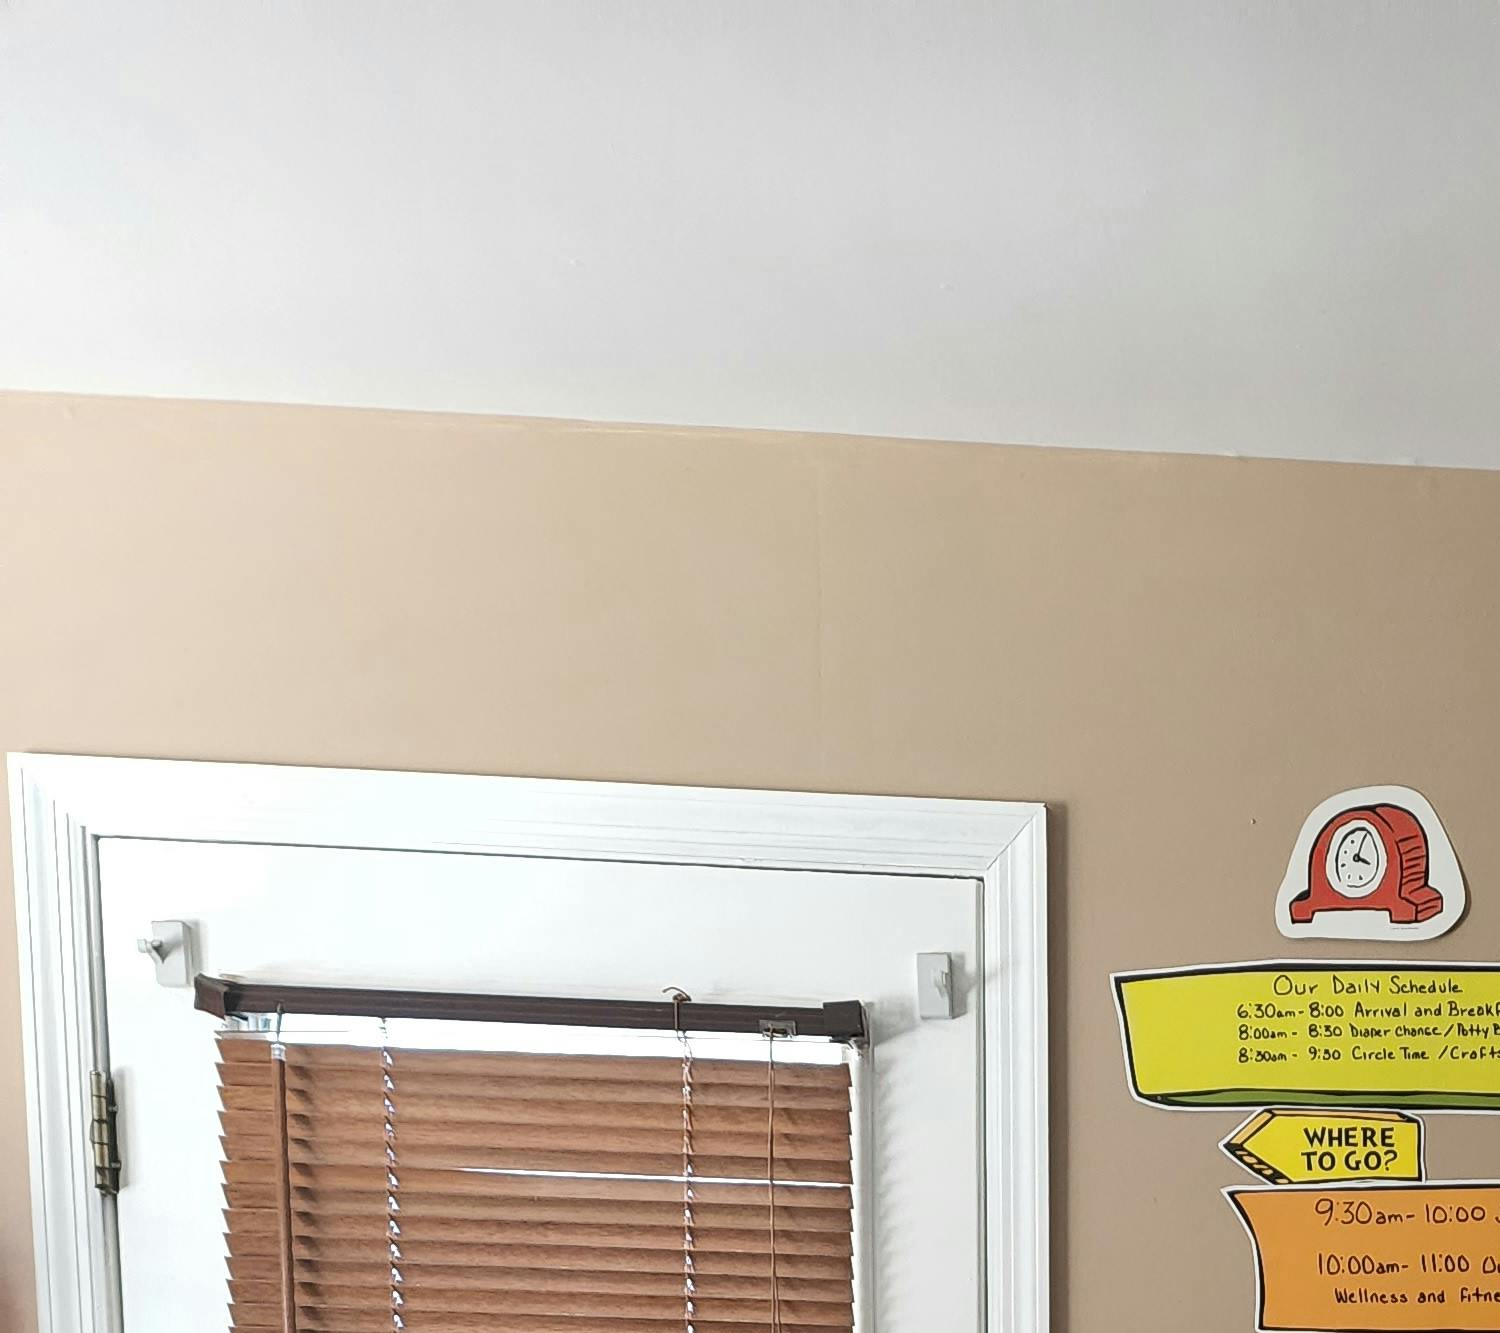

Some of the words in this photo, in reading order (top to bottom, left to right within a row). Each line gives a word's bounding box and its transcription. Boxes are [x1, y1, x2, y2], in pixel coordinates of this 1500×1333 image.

[1274, 974, 1318, 995] Our
[1332, 974, 1380, 994] Daily
[1389, 975, 1463, 994] Schedule
[1355, 1001, 1407, 1018] Arrival
[1414, 1002, 1442, 1017] and
[1308, 1023, 1343, 1039] 8:30
[1349, 1022, 1391, 1038] Diaper
[1308, 1046, 1341, 1061] 9:30
[1352, 1046, 1395, 1061] Circle
[1399, 1046, 1429, 1060] Time
[1303, 1126, 1395, 1149] WHERE
[1301, 1151, 1336, 1172] TO
[1344, 1150, 1398, 1172] GO?
[1424, 1203, 1486, 1224] 10:00
[1420, 1253, 1470, 1273] 11:00
[1334, 1287, 1408, 1304] Wellness
[1417, 1288, 1445, 1304] and
